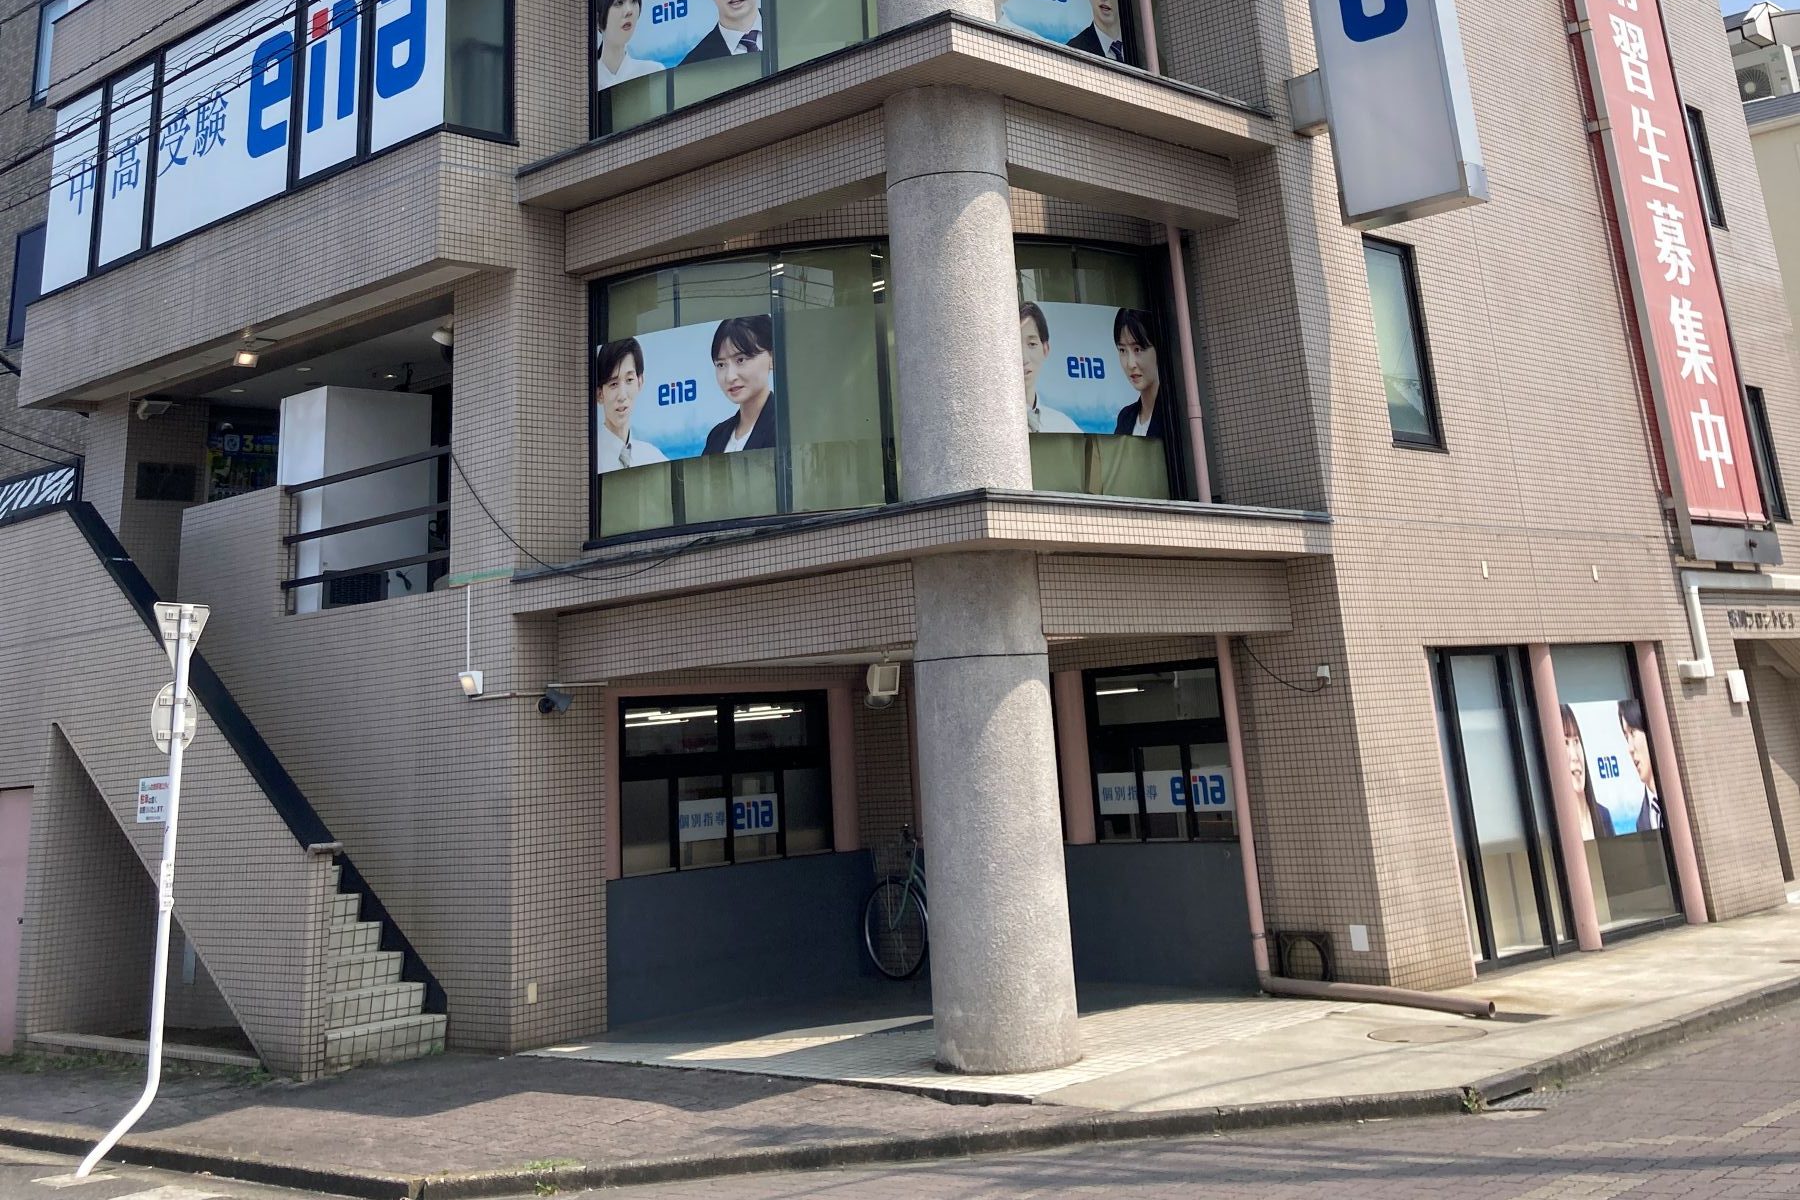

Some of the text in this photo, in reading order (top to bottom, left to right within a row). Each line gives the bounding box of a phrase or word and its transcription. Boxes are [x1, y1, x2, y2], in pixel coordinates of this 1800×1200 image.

[69, 91, 229, 216] 中高受験
[1067, 356, 1105, 380] ena
[658, 378, 697, 407] ena
[1598, 756, 1619, 779] ena
[1170, 774, 1226, 806] ena
[733, 800, 774, 830] ena
